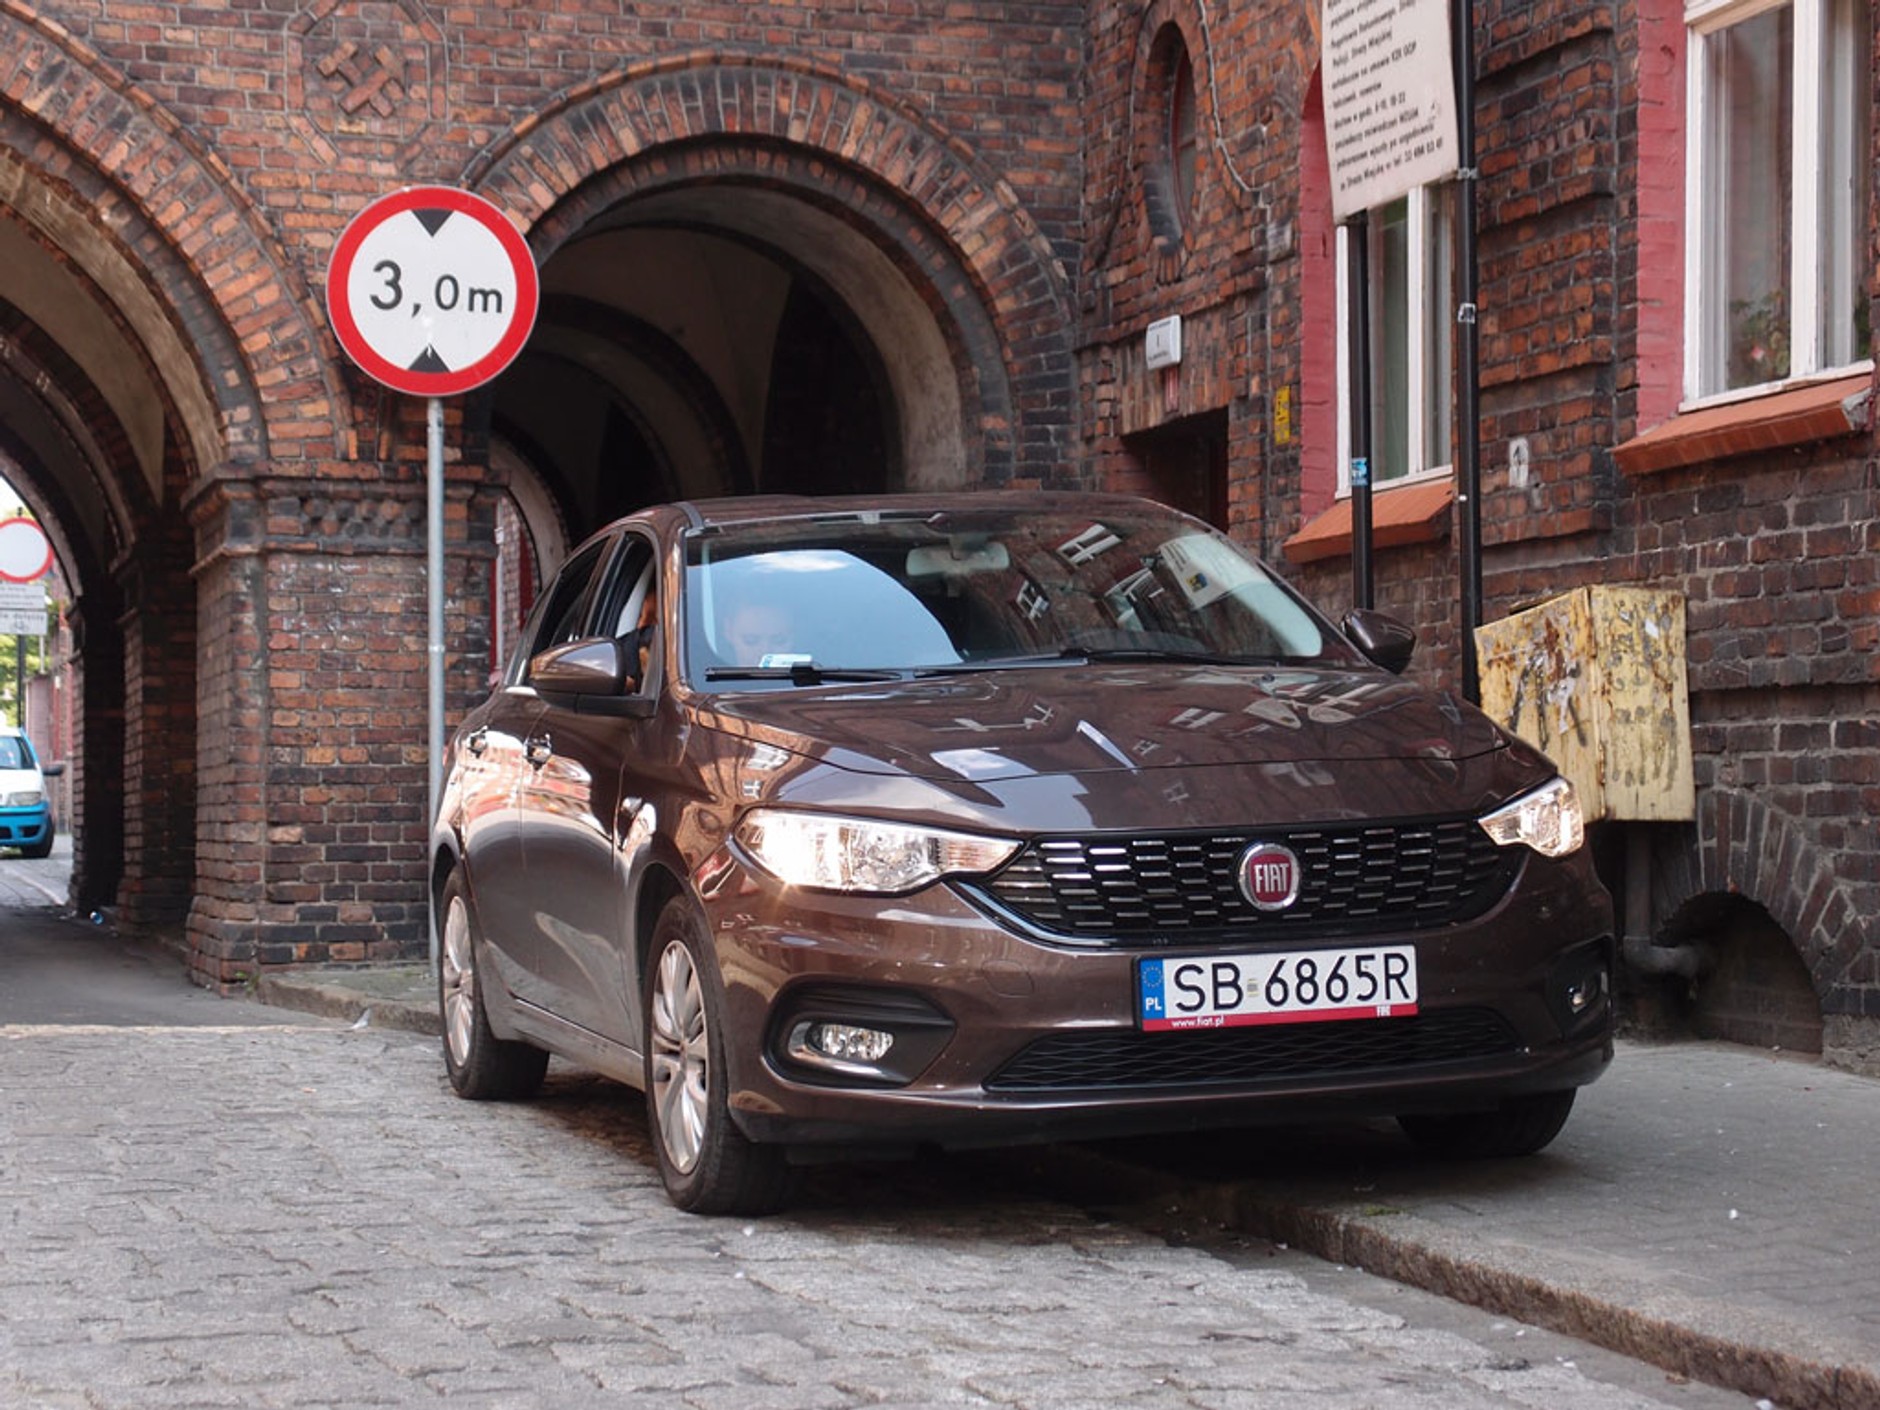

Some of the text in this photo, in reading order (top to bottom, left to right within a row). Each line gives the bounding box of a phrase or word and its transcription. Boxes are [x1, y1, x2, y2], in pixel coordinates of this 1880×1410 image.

[1253, 862, 1289, 894] FIAT
[1173, 952, 1410, 1012] SB 6865R
[1145, 997, 1162, 1011] PL
[1171, 1014, 1225, 1028] www.fiat.pl
